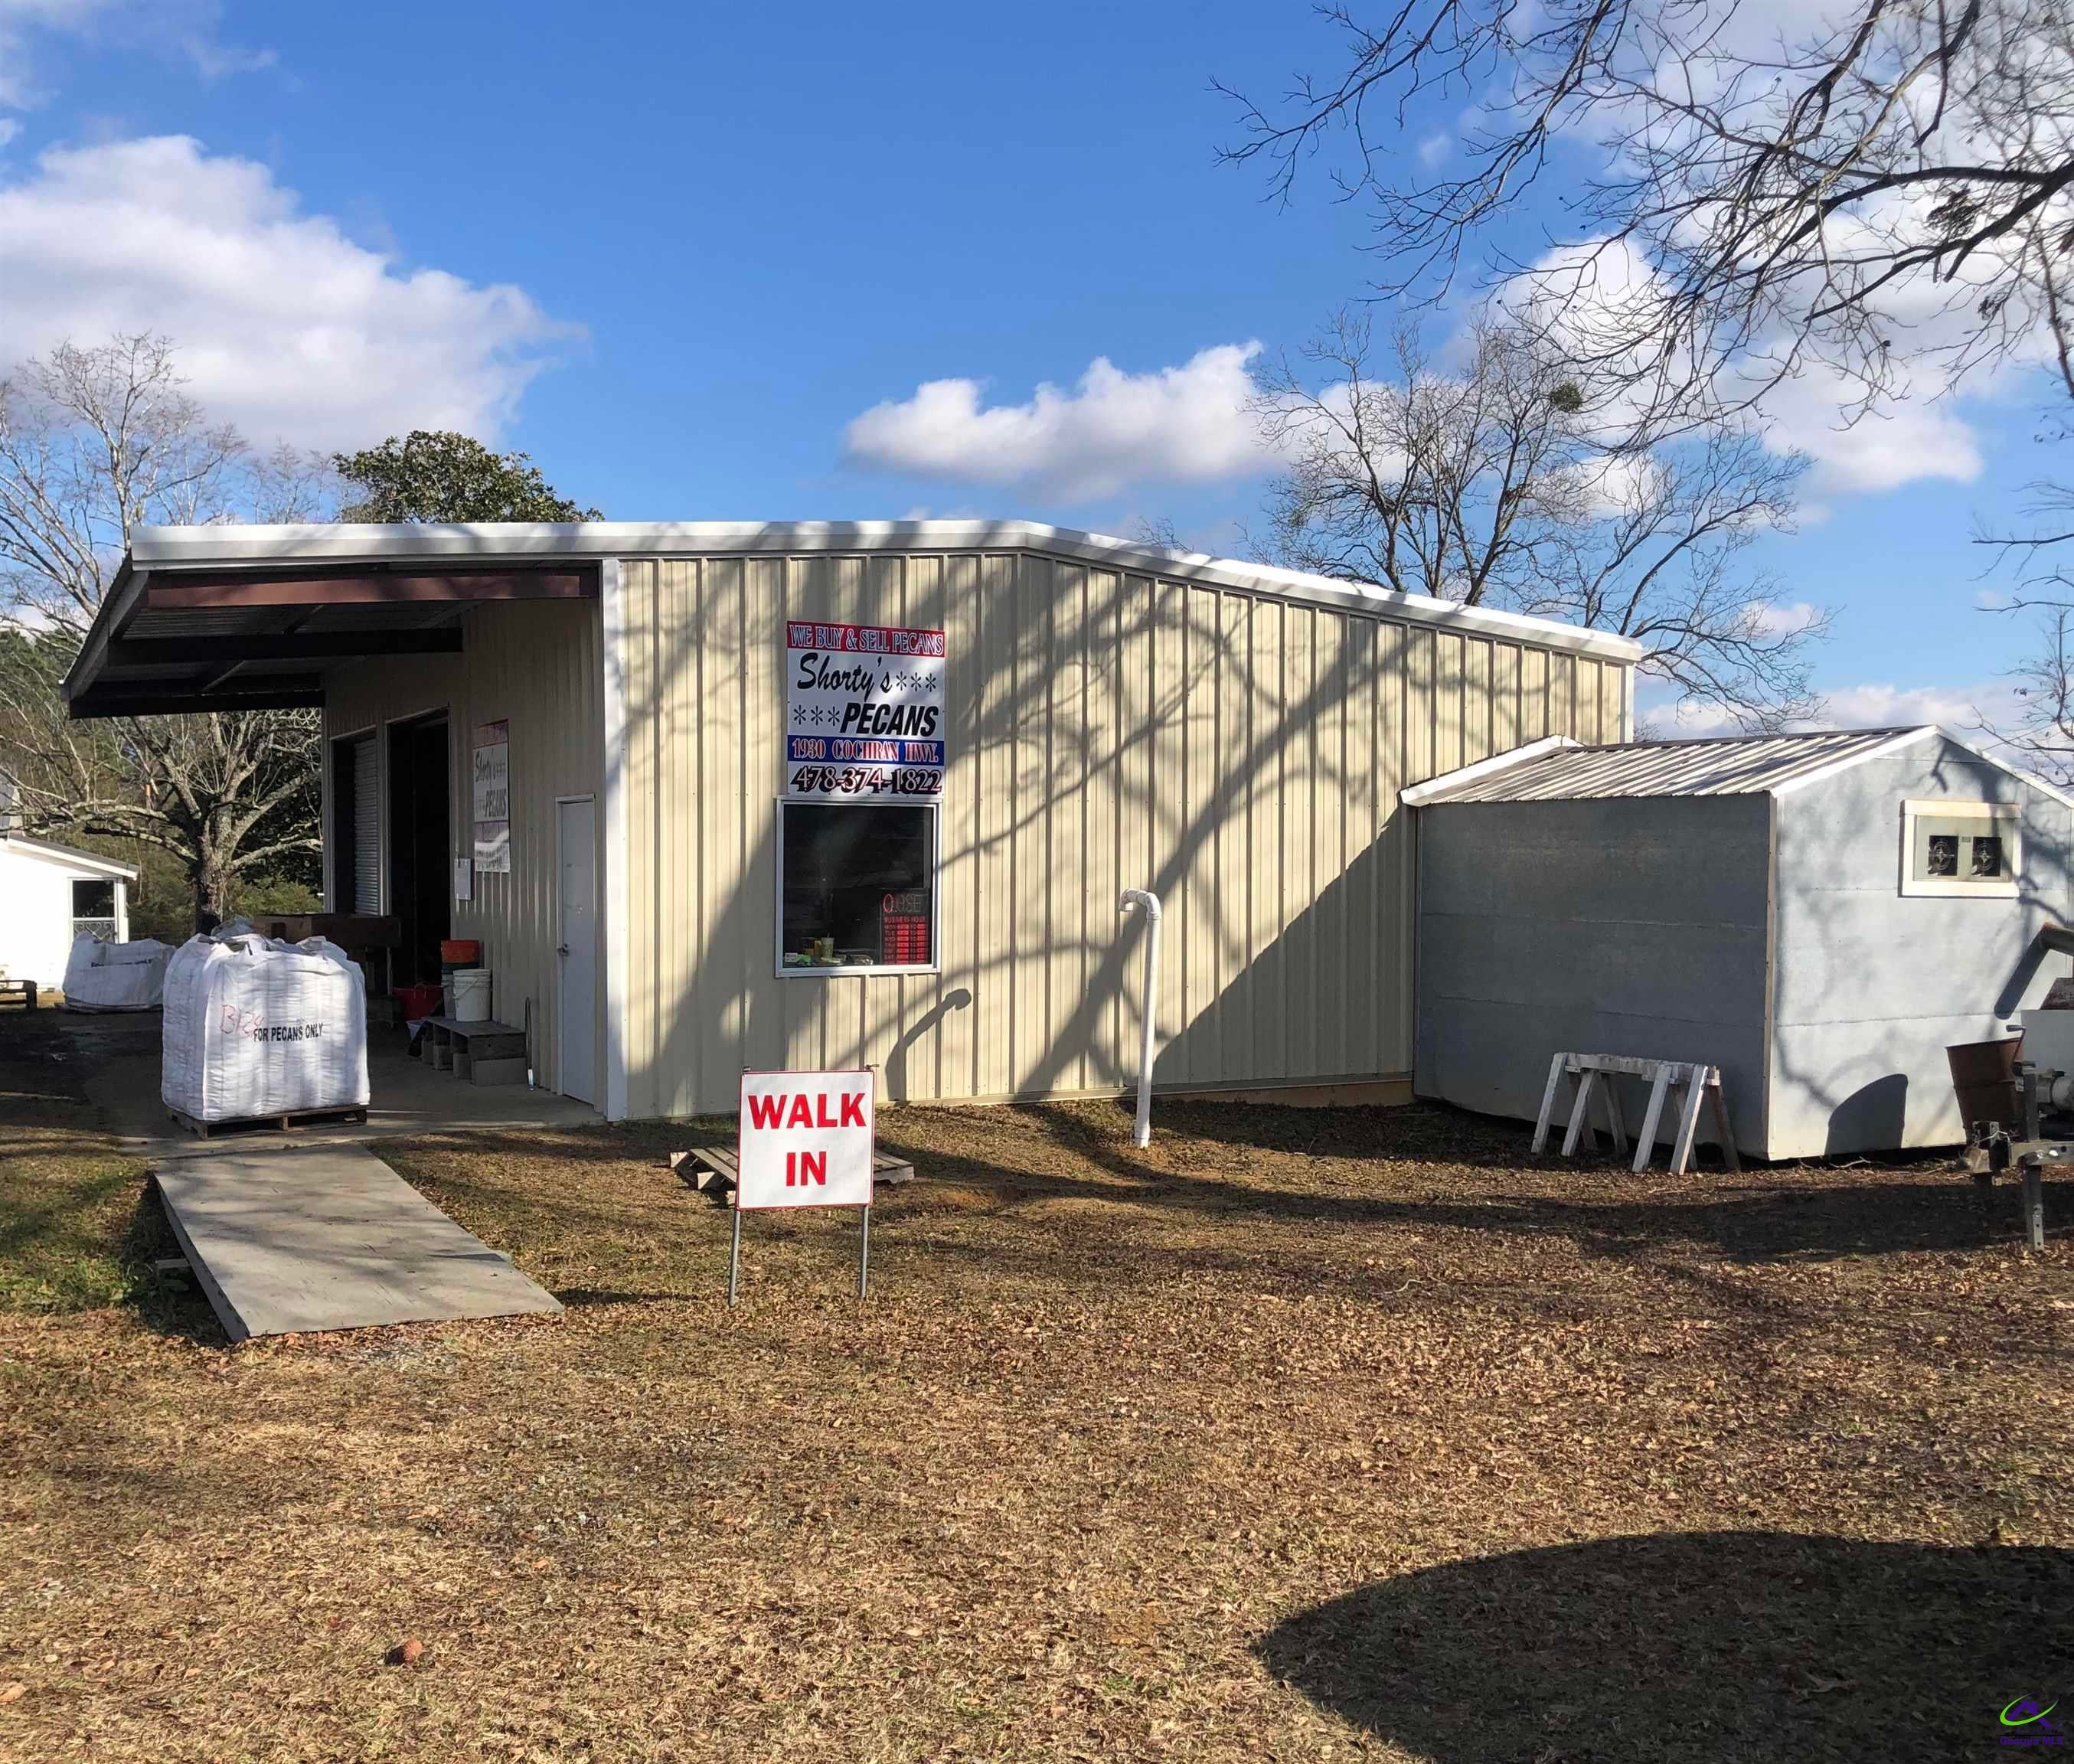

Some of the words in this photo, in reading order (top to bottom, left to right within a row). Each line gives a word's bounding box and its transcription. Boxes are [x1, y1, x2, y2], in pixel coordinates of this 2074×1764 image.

[789, 625, 812, 648] WE
[815, 626, 844, 649] BUY
[846, 629, 857, 649] &
[859, 629, 889, 651] SELL
[891, 631, 944, 655] PECANS
[840, 703, 939, 737] PECANS
[792, 738, 826, 760] 1930
[832, 740, 900, 761] COCHRAN
[790, 766, 942, 795] 478-374-1822
[253, 1027, 269, 1042] FOR
[272, 1026, 303, 1041] PECANS
[305, 1023, 323, 1038] ONLY
[748, 1093, 866, 1129] WALK
[786, 1152, 826, 1186] IN
